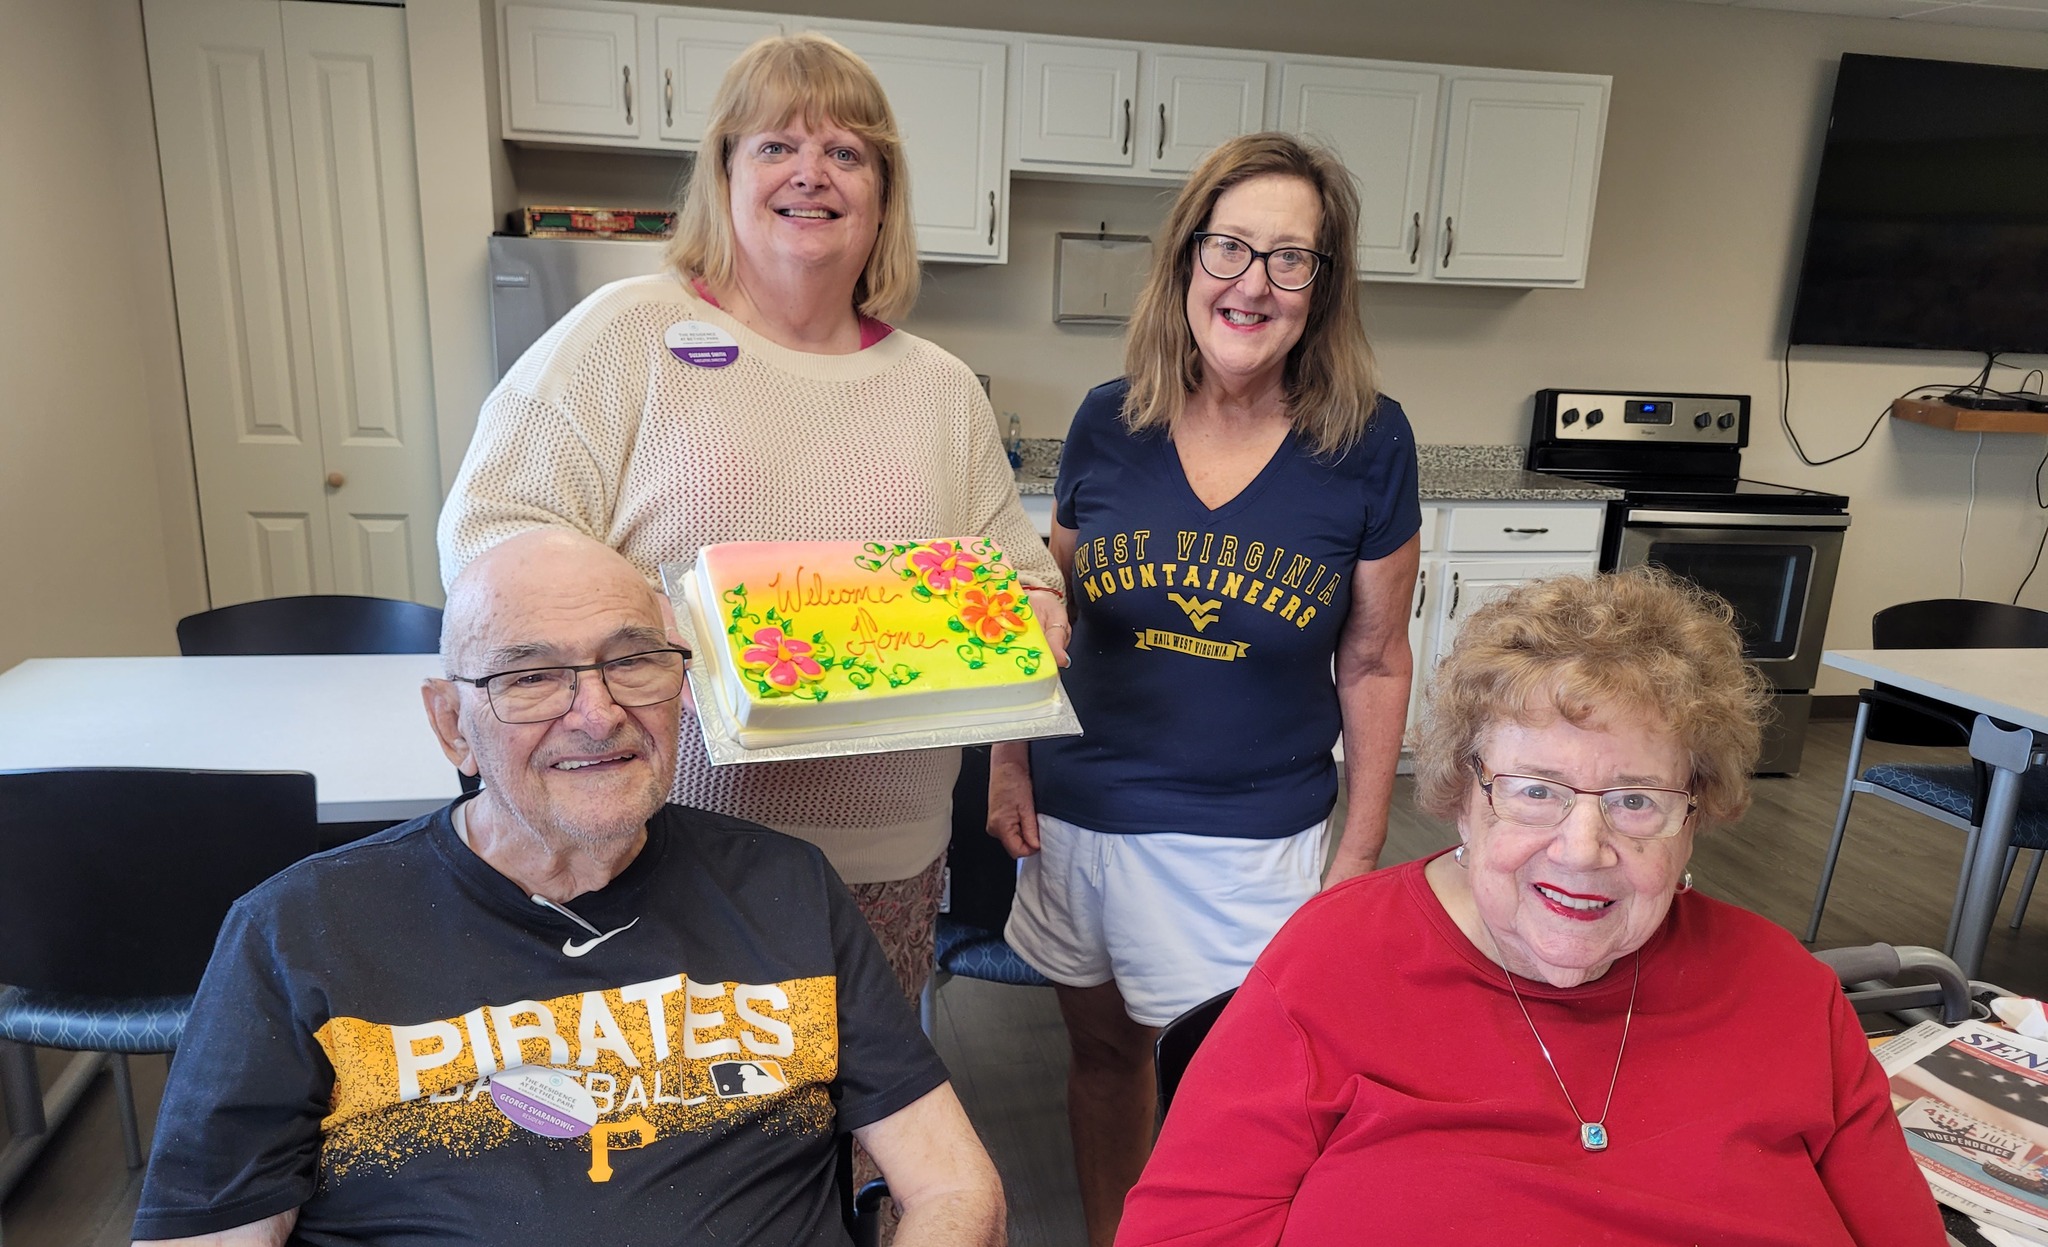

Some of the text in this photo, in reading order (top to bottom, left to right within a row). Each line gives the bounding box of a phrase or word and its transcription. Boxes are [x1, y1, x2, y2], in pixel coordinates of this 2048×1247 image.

[1075, 530, 1341, 606] WEST VIRGINIA
[769, 566, 902, 613] Welcome
[1082, 563, 1317, 628] MOUNTAINEERS
[846, 607, 948, 663] Home
[1153, 633, 1227, 657] HAIL WEST VIRGINIA
[391, 973, 794, 1102] PIRATES
[1957, 1033, 2048, 1077] SEN
[524, 1076, 577, 1103] THE RESIDENCE
[530, 1084, 555, 1100] BETHEL
[556, 1097, 575, 1109] PARK
[500, 1094, 575, 1132] GEORGE SVARANOWIC
[522, 1113, 545, 1126] RESIDENT
[1923, 1108, 1959, 1127] 4th
[587, 1114, 657, 1183] P
[1923, 1131, 2010, 1158] INDEPENDENCE
[1980, 1132, 2023, 1151] JULY
